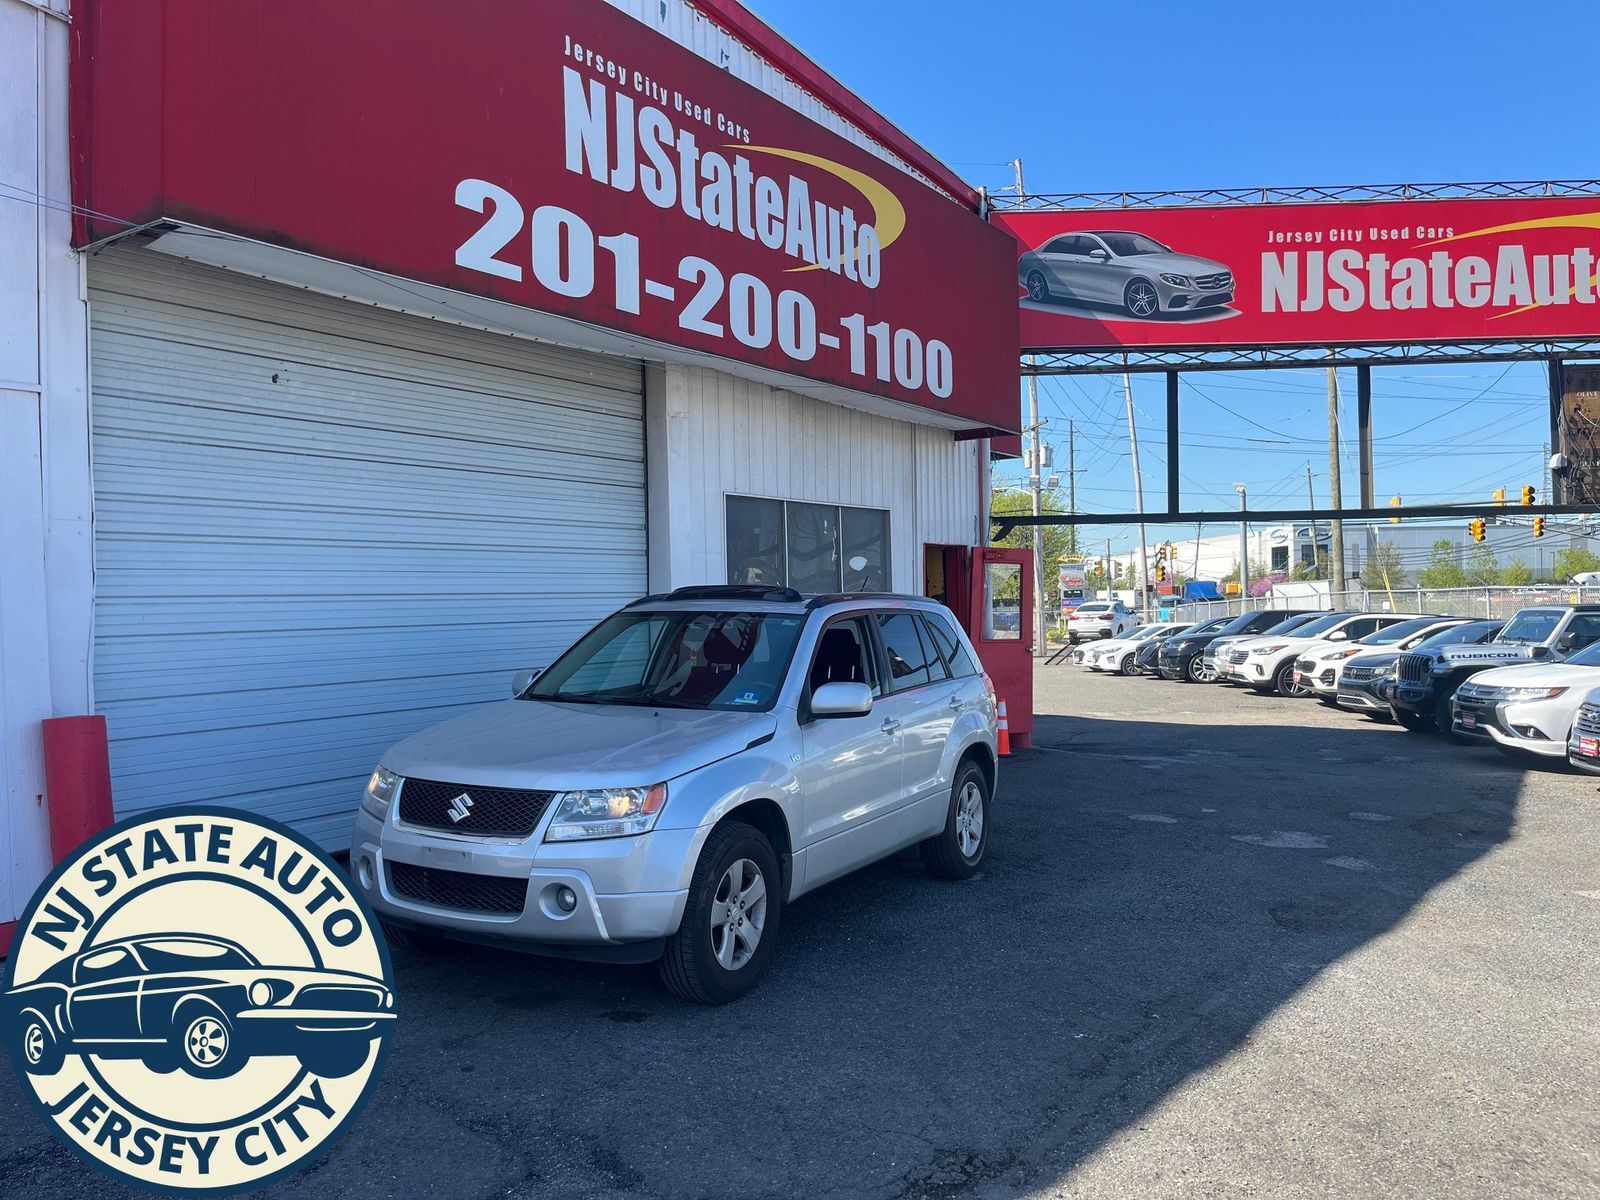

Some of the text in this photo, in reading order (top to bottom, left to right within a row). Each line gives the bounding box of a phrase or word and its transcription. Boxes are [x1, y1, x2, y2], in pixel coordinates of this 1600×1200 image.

[564, 35, 751, 144] Jersey City Used Cars
[562, 65, 881, 289] NJStateAuto
[455, 178, 954, 399] 201-200-1100
[1261, 244, 1600, 313] NJStateAut
[1268, 225, 1455, 244] Jersey City Used Cars
